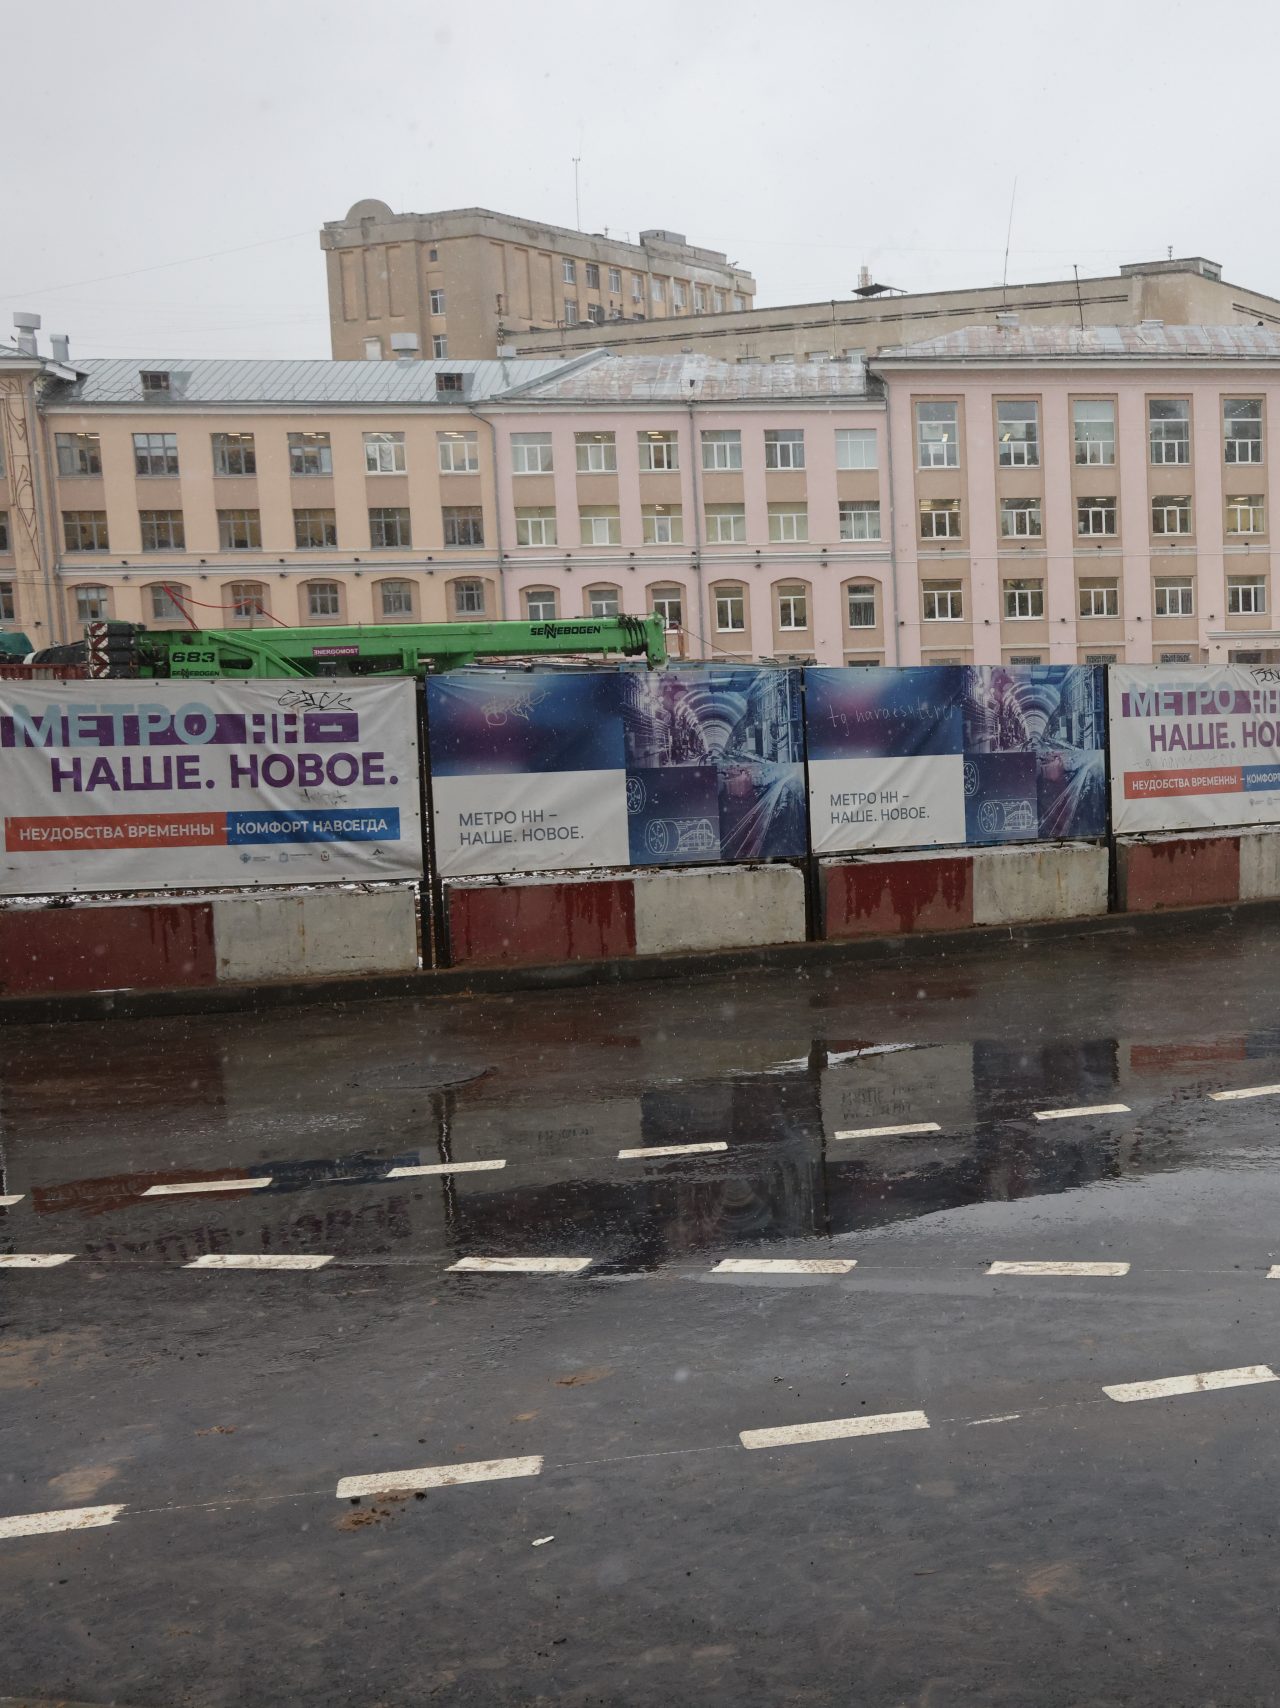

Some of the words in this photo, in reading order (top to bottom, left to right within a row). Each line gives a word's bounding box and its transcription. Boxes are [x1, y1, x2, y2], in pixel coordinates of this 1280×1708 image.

[530, 623, 600, 639] SENNEBOGEN
[172, 651, 215, 663] 683
[1128, 681, 1236, 717] МЕТРО
[12, 702, 216, 747] МЕТРО
[1150, 722, 1236, 752] НАШЕ.
[50, 755, 215, 792] НАШЕ.
[229, 752, 399, 789] НОВОЕ.
[1132, 777, 1190, 791] НЕУДОБСТВА
[1191, 775, 1237, 787] ВРЕМЕННЫ
[830, 792, 877, 806] МЕТРО
[880, 791, 898, 804] НН
[459, 811, 517, 827] МЕТРО
[521, 809, 544, 823] НН
[831, 810, 877, 824] НАШЕ.
[881, 806, 930, 821] НОВОЕ.
[19, 826, 124, 842] НЕУДОБСТВА
[128, 824, 215, 838] ВРЕМЕННЫ
[236, 821, 309, 835] КОМФОРТ
[312, 818, 388, 833] НАВСЕГДА
[460, 830, 517, 845] НАШЕ.
[522, 826, 584, 842] НОВОЕ.
